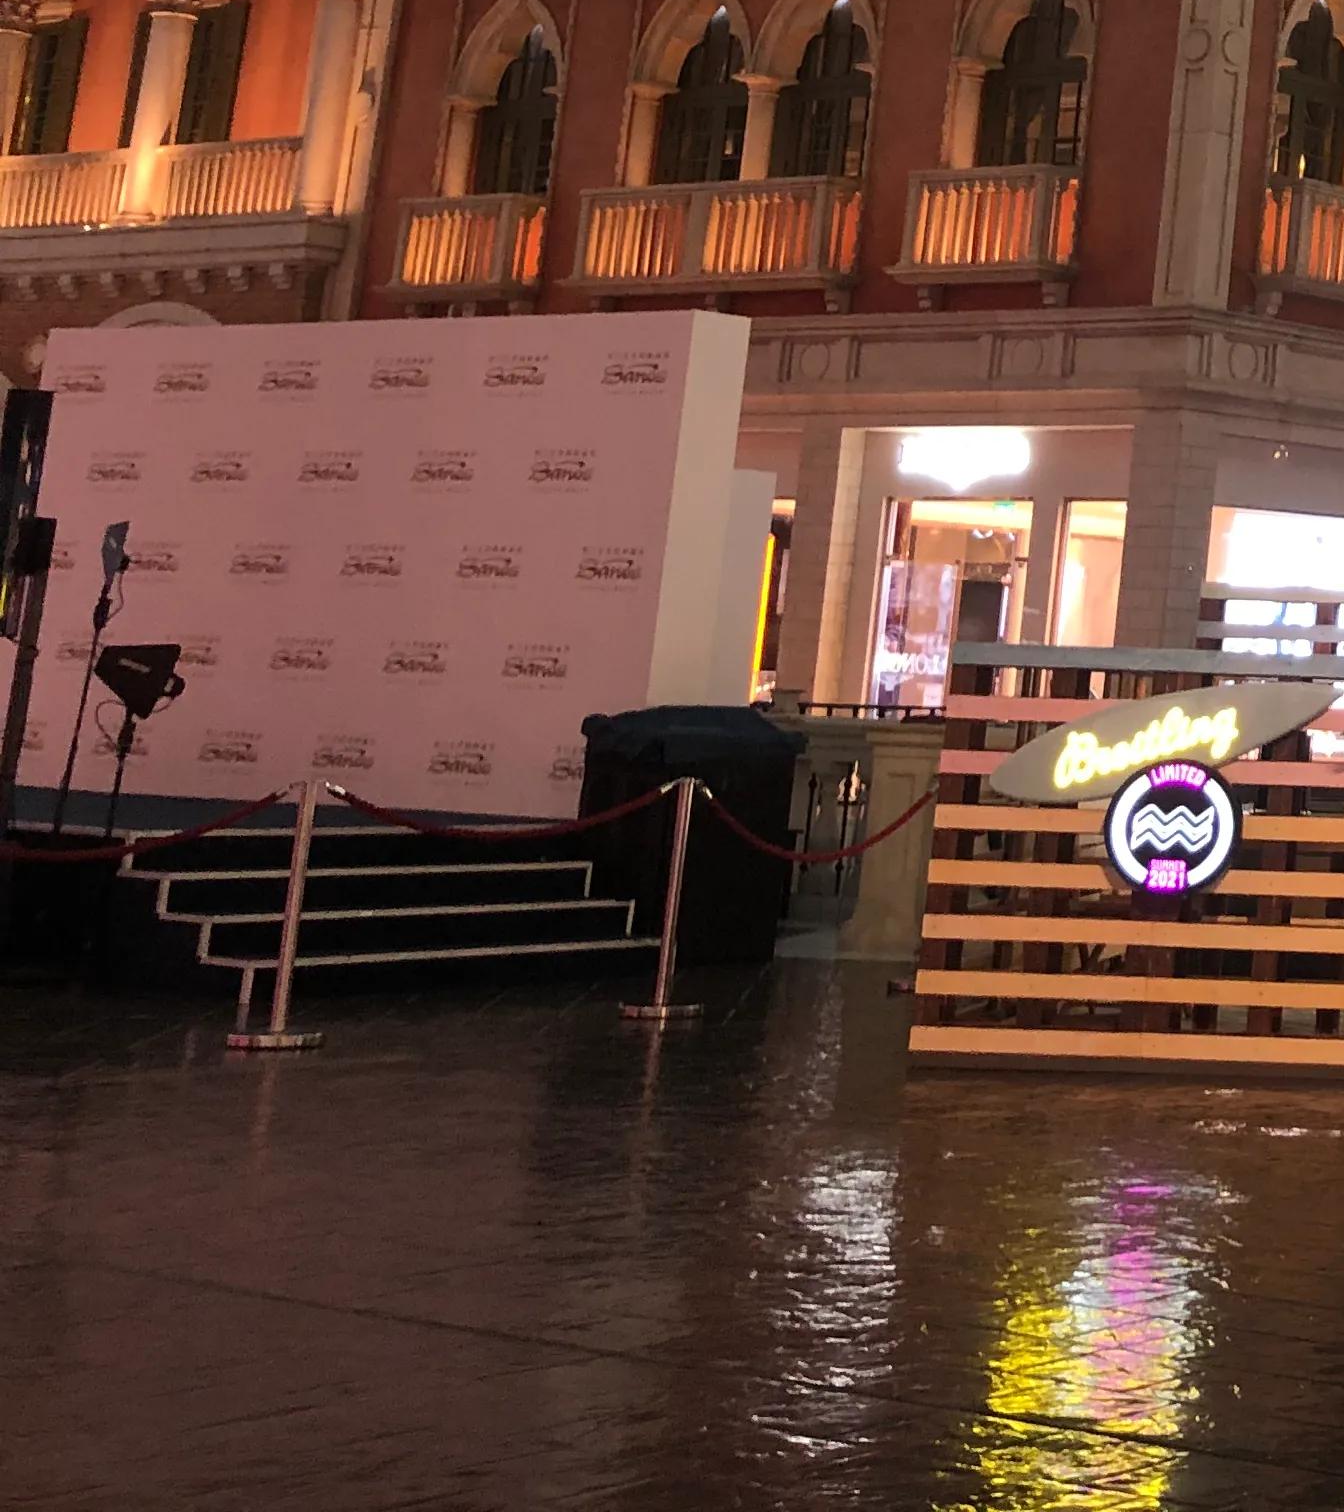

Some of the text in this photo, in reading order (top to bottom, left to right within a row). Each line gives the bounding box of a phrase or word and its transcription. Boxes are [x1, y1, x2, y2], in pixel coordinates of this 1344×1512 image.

[1054, 706, 1239, 788] Breitling
[1151, 763, 1207, 787] LIMITED
[1150, 859, 1187, 870] SUMMER
[1149, 870, 1186, 888] 2021
